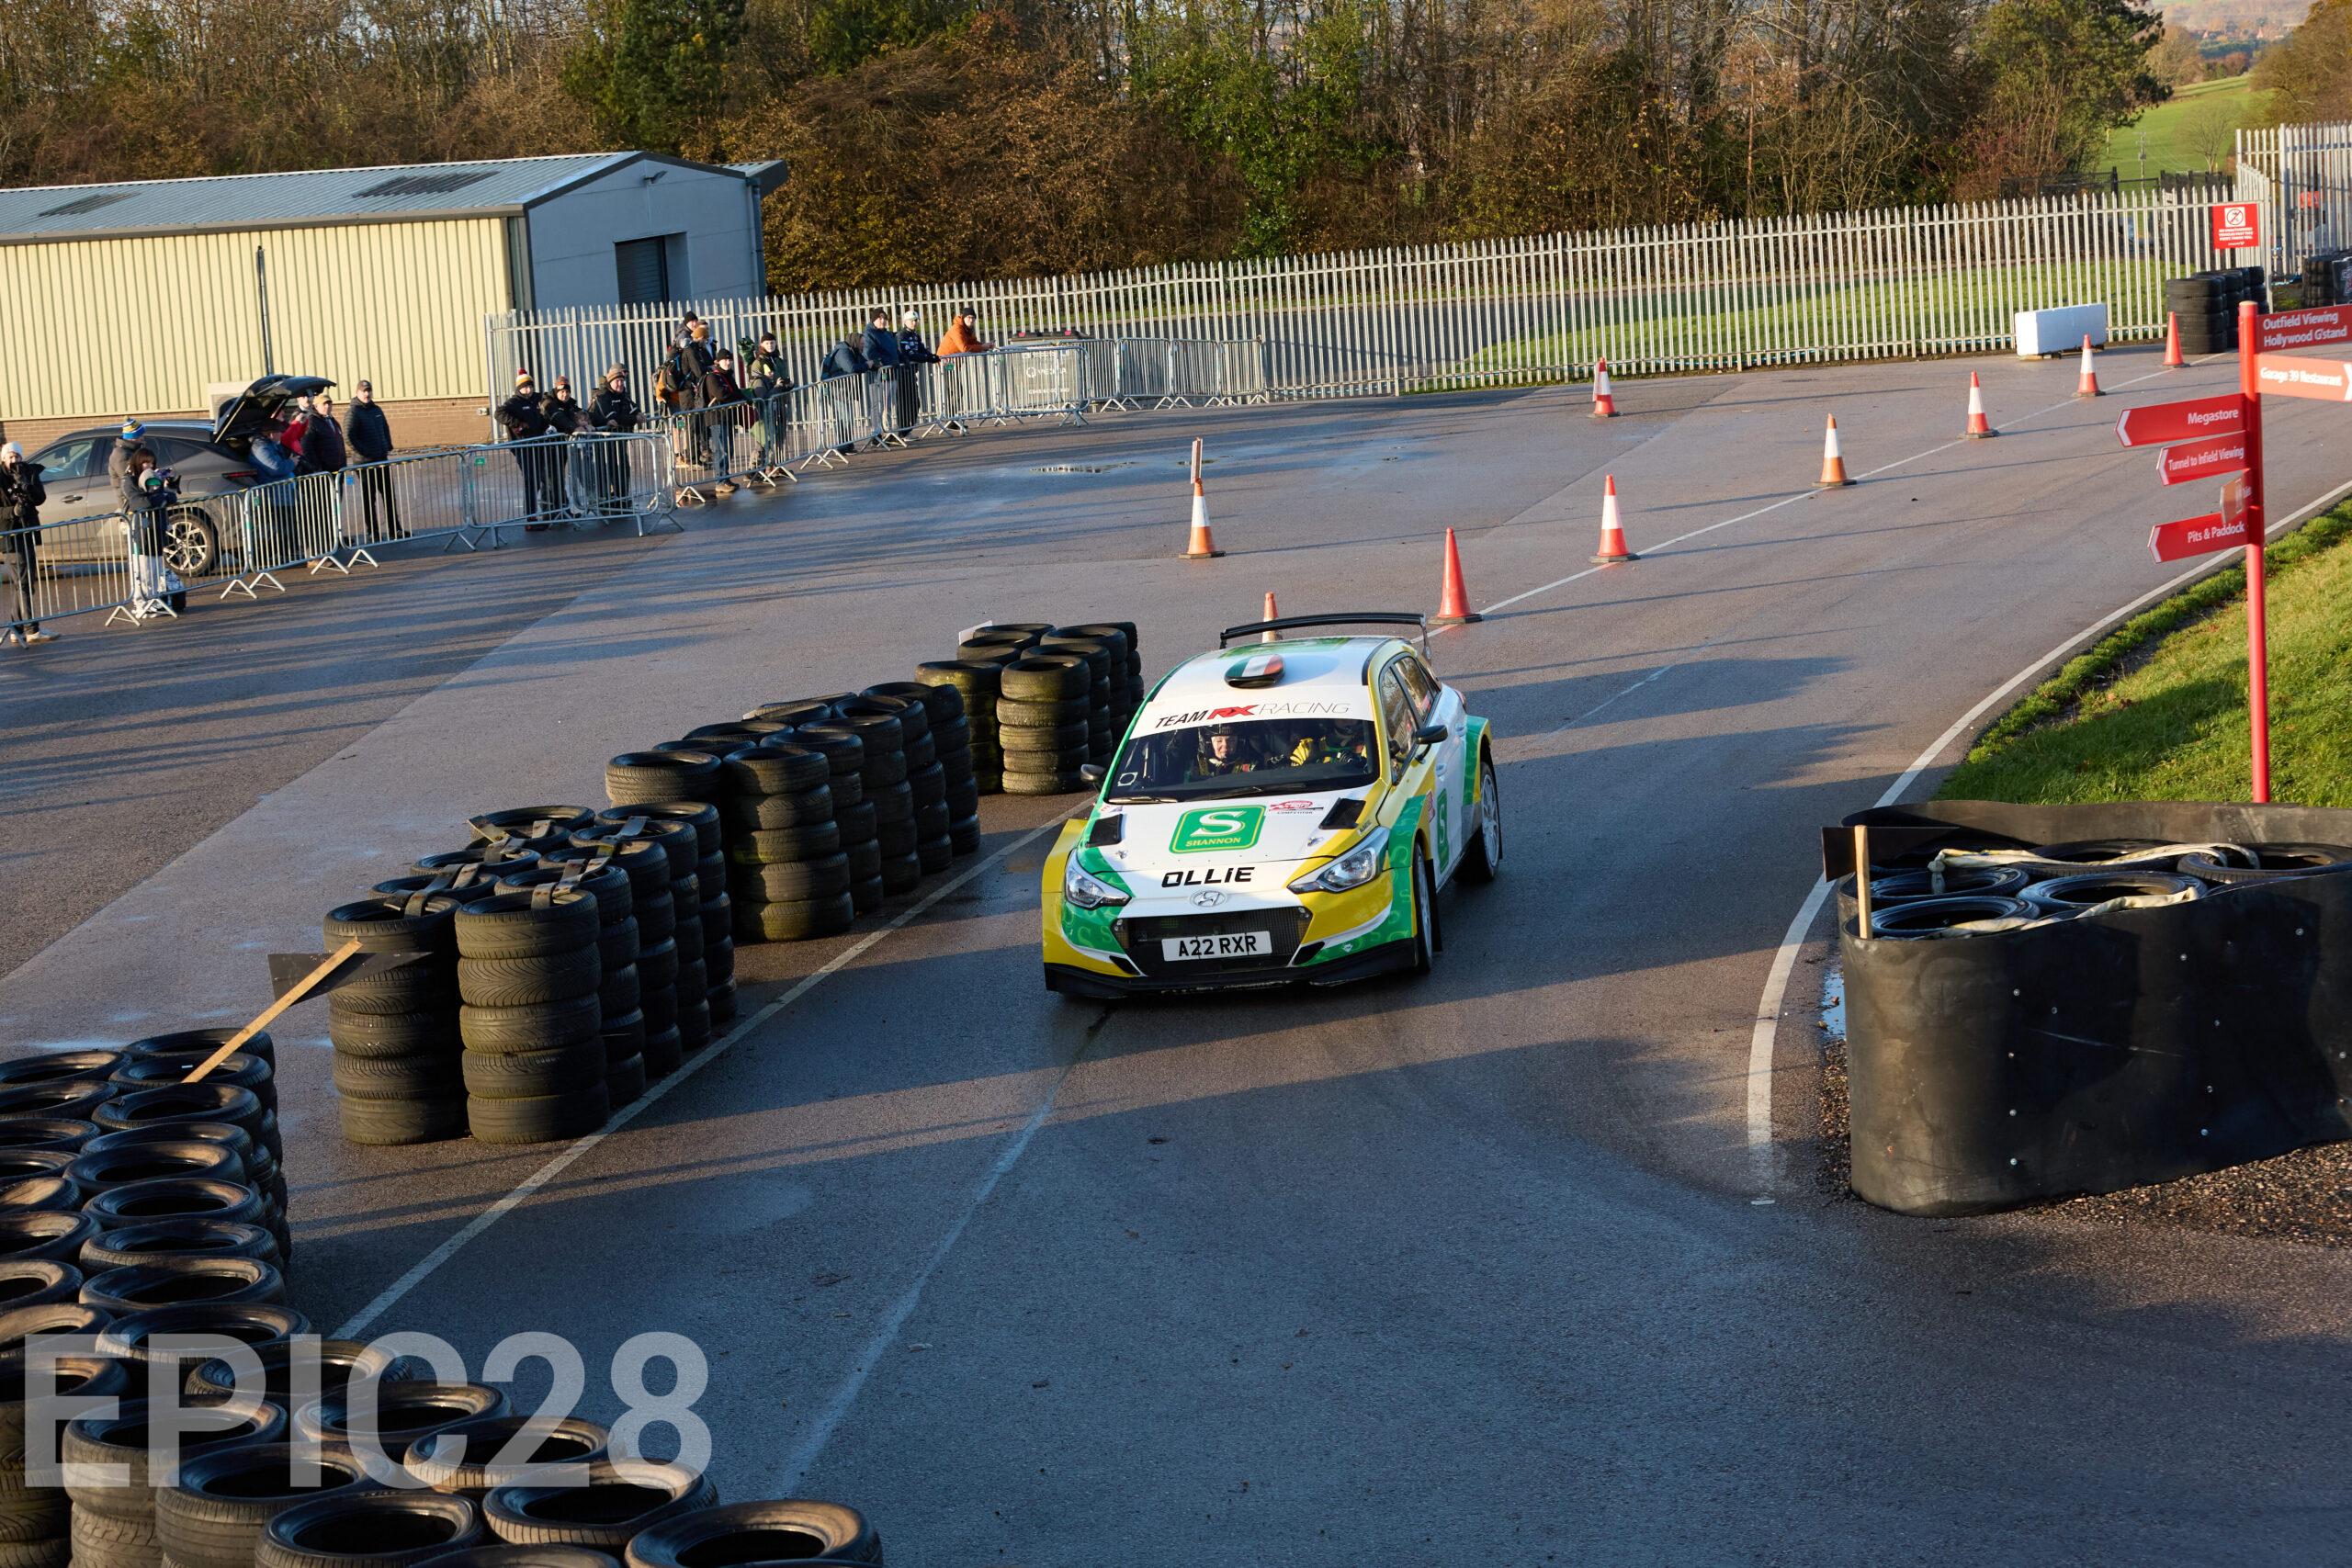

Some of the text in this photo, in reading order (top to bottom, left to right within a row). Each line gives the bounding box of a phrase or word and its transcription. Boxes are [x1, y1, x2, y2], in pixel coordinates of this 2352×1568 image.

[2263, 310, 2338, 330] Outfield Viewing
[2264, 325, 2347, 348] Hollywood G'stand
[2260, 367, 2342, 386] Garage 39 Restaurant
[2188, 409, 2239, 425] Megastore
[2168, 446, 2245, 471] Tunnel to Infield Viewing
[2188, 521, 2245, 544] Pits & Paddock
[1154, 702, 1351, 728] TEAM RX RACING
[1190, 810, 1247, 837] S
[1185, 837, 1241, 847] SHANNON
[1179, 935, 1257, 957] A22 RXR
